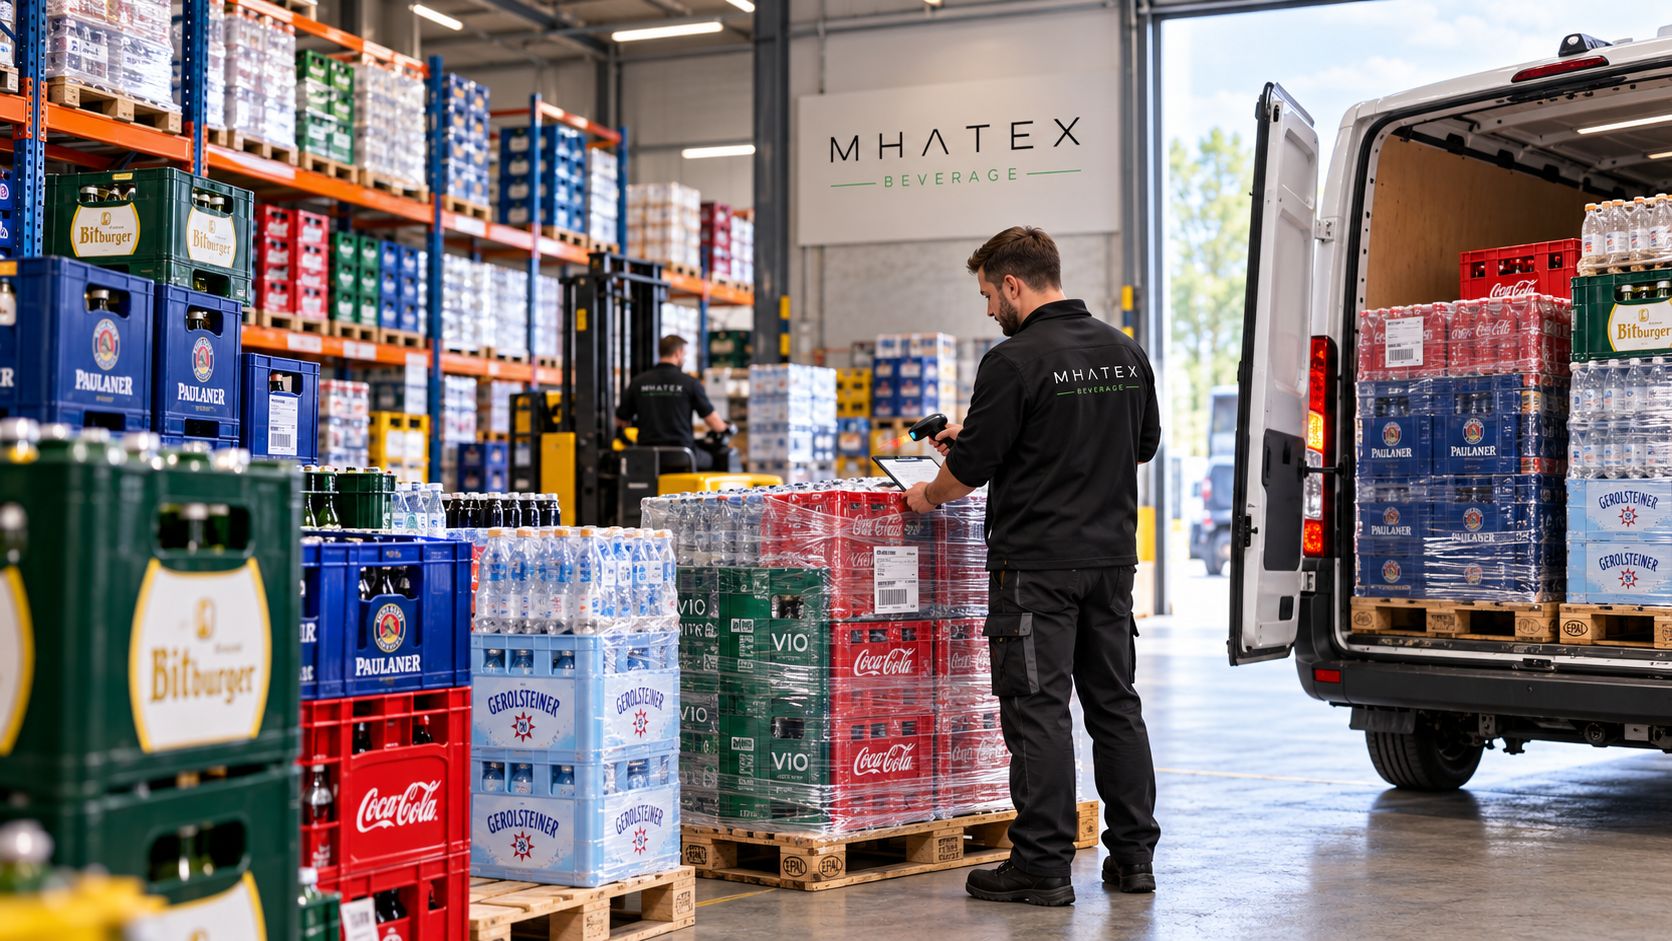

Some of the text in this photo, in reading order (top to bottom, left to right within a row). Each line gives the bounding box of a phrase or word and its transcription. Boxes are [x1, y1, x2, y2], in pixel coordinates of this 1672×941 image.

[831, 117, 1080, 163] MHATEX
[884, 167, 1017, 188] BEVERAGE
[79, 226, 132, 246] Bitburger
[193, 229, 231, 256] Bitburger
[1617, 323, 1672, 340] Bitburger
[74, 368, 133, 396] PAULANER
[1053, 365, 1138, 384] MHATEX
[178, 382, 225, 406] PAULANER
[1077, 384, 1124, 395] BEVERAGE
[1371, 448, 1412, 458] PAULANER
[1450, 445, 1496, 457] PAULANER
[1598, 490, 1659, 510] GEROLSTEINER
[1598, 552, 1659, 573] GEROLSTEINER
[678, 599, 705, 615] VIO
[771, 633, 808, 653] VIO
[355, 654, 421, 677] PAULANER
[853, 648, 916, 677] Coca-Cola
[150, 648, 256, 704] Bitburger
[488, 689, 560, 718] GEROLSTEINER
[616, 687, 665, 715] GEROLSTEINER
[853, 743, 916, 777] Coca-Cola
[356, 779, 442, 833] Coca-Cola
[487, 809, 559, 838] GEROLSTEINER
[615, 804, 664, 835] GEROLSTEINER
